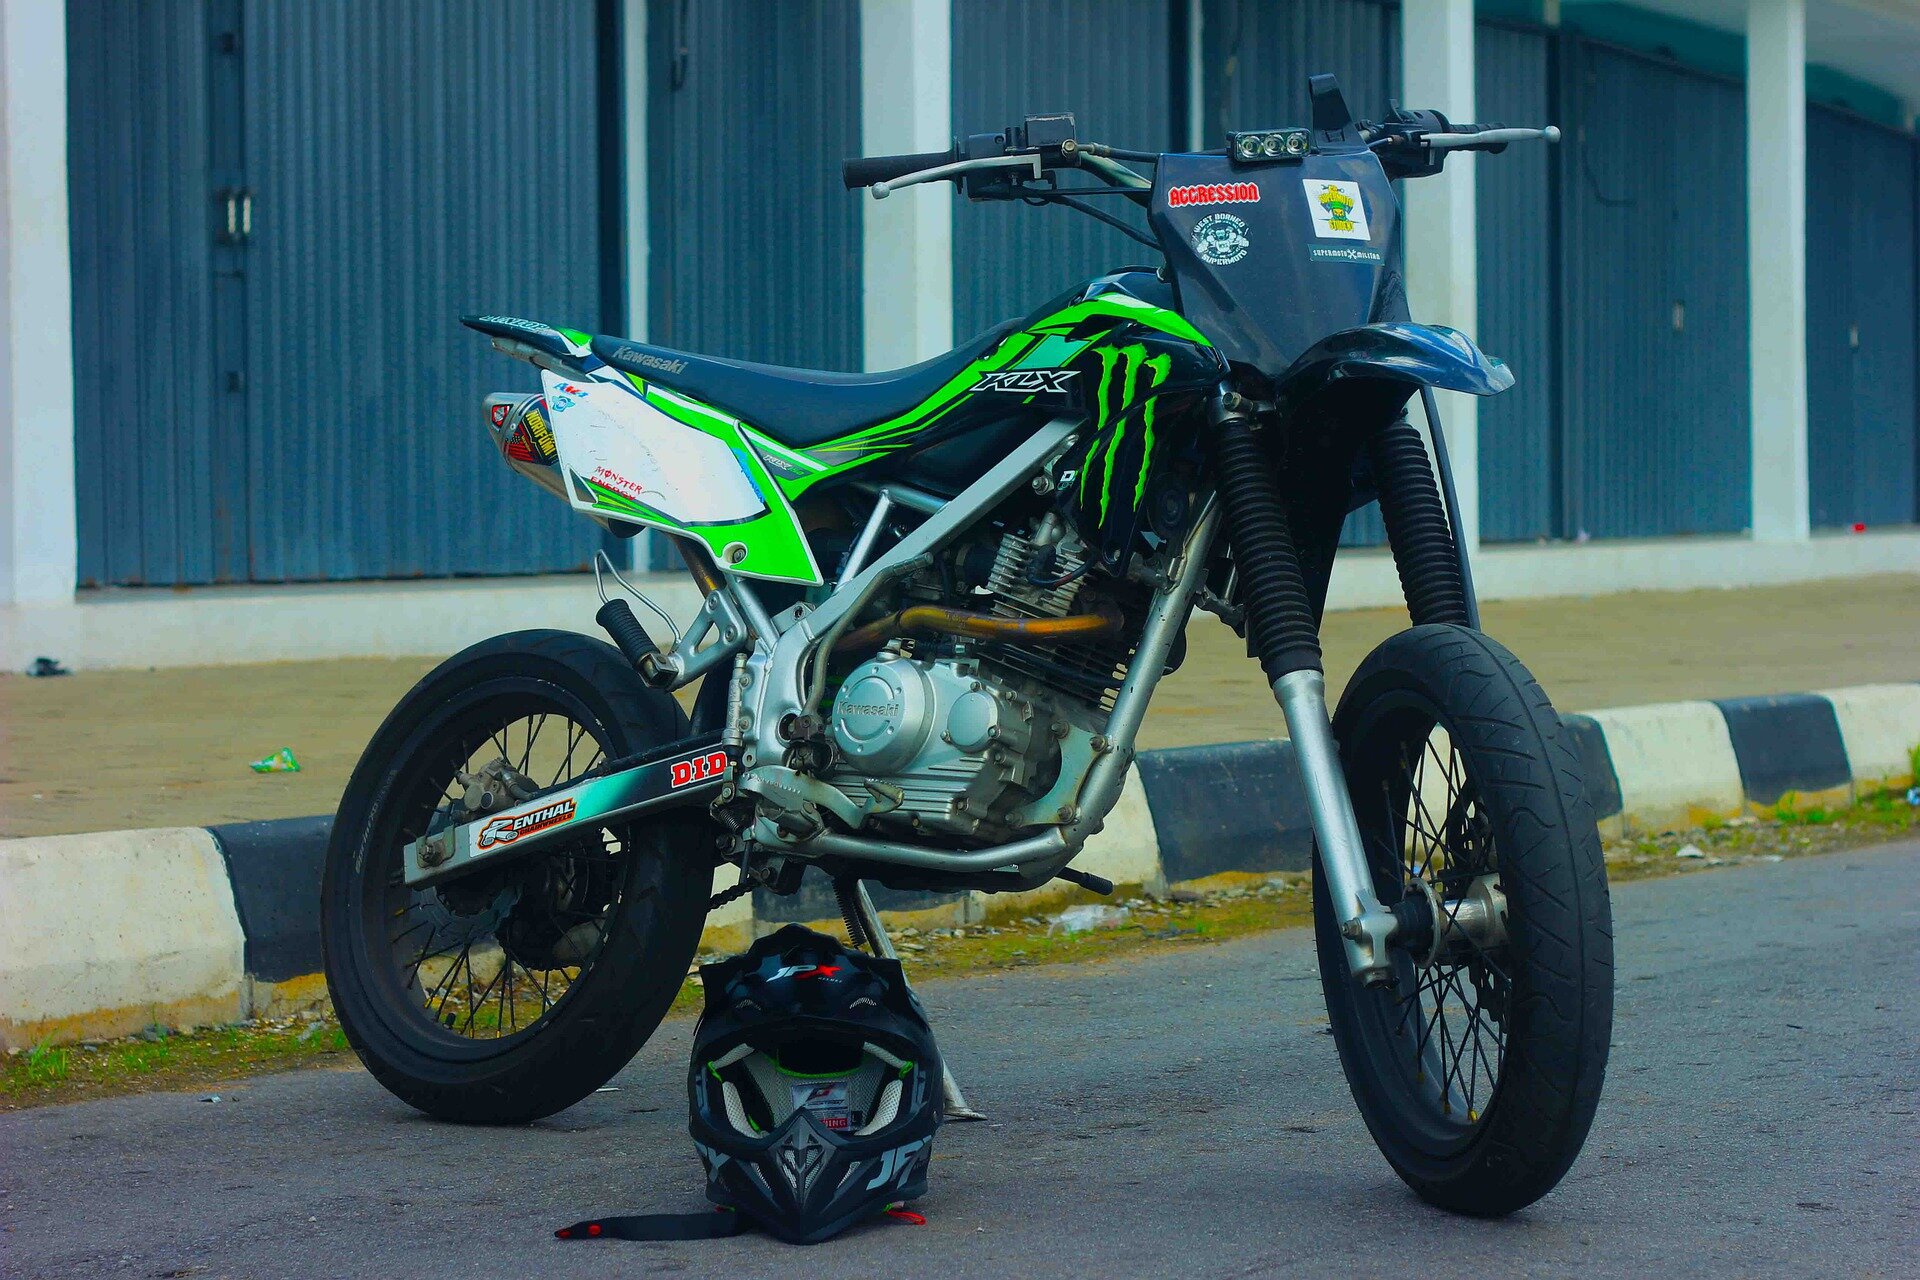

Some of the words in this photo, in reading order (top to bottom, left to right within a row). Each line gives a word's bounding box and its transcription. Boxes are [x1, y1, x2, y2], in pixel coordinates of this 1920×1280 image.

[1193, 215, 1213, 233] WEST
[1214, 213, 1246, 228] BORNEO
[1201, 249, 1248, 266] SUPERMOTO
[1313, 249, 1347, 257] SUPERMOTO
[612, 346, 689, 375] Kawasaki
[969, 370, 1082, 393] KLX
[525, 410, 556, 456] NORIFUMI
[836, 700, 900, 718] Kawasaki
[480, 800, 575, 847] RENTHAL
